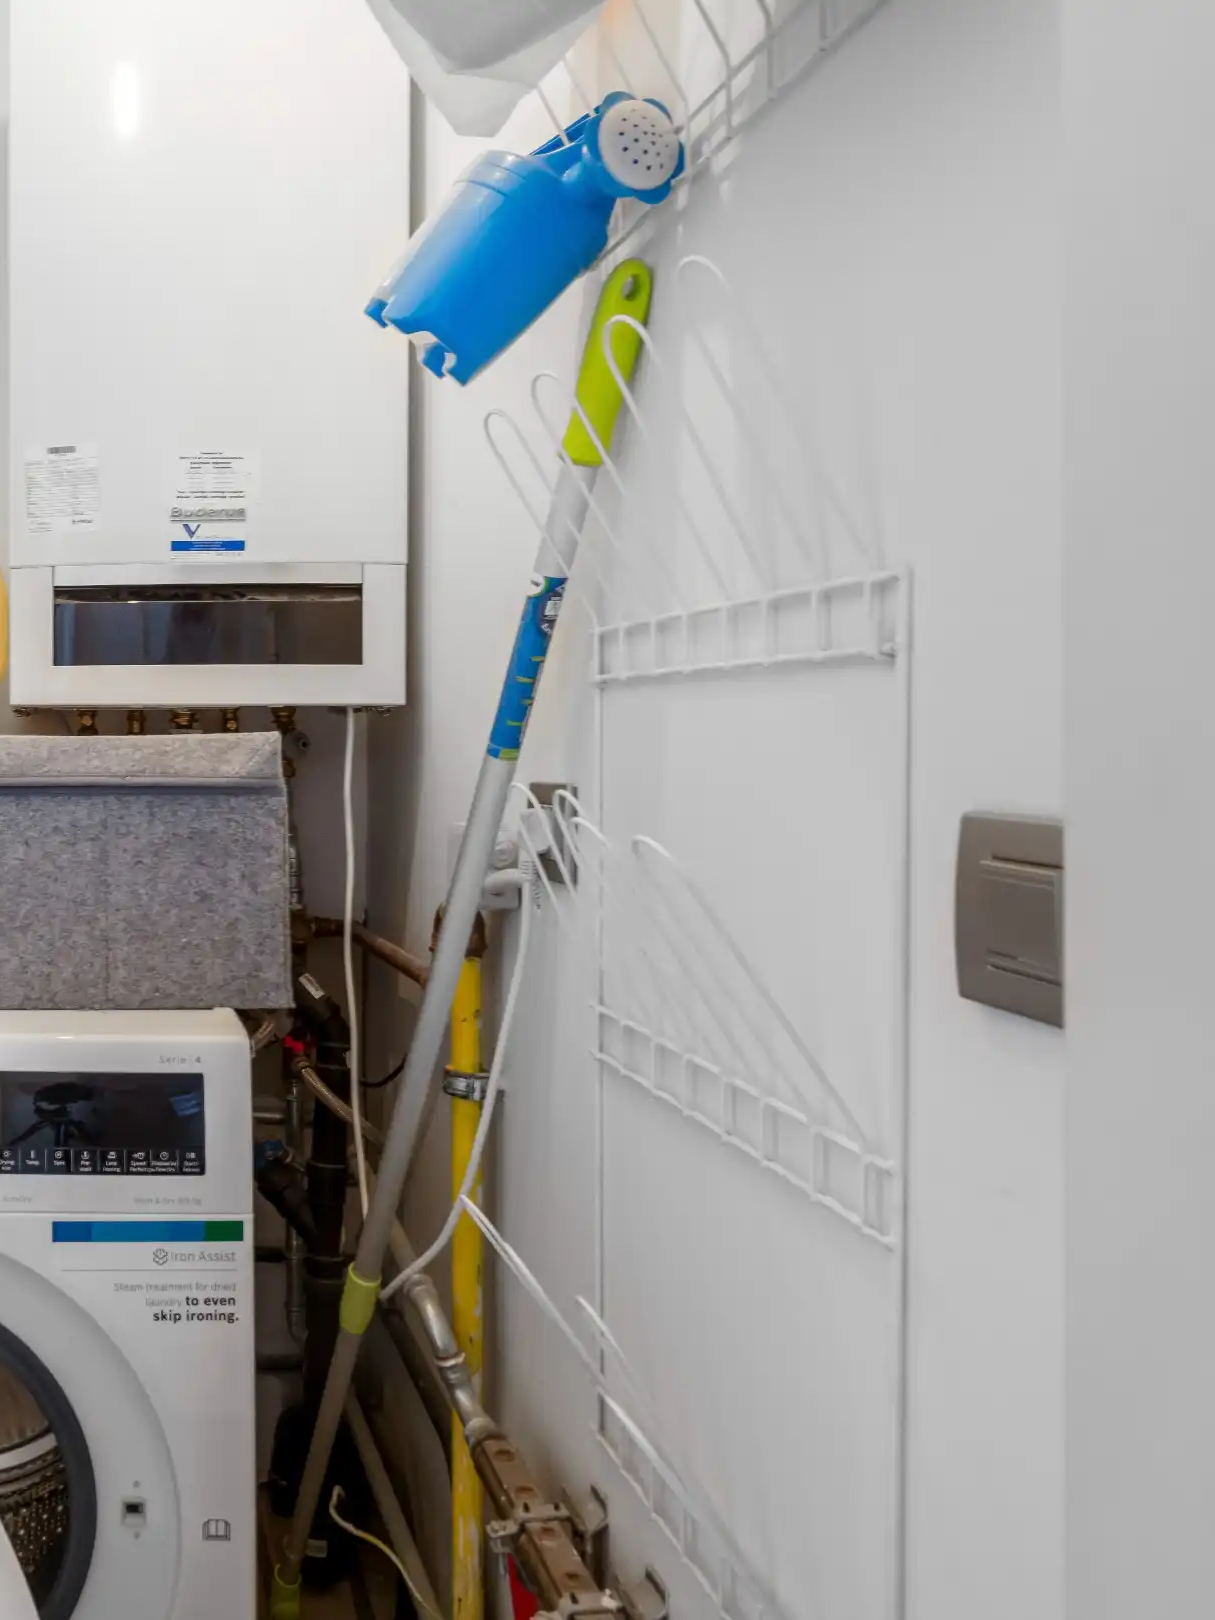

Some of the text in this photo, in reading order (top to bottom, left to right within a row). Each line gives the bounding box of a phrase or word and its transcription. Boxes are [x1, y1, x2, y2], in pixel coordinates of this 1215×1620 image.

[171, 1251, 237, 1262] Iron Assist
[113, 1282, 144, 1292] Steam
[185, 1296, 199, 1306] to
[203, 1297, 236, 1306] even
[153, 1309, 239, 1324] skip ironing.
